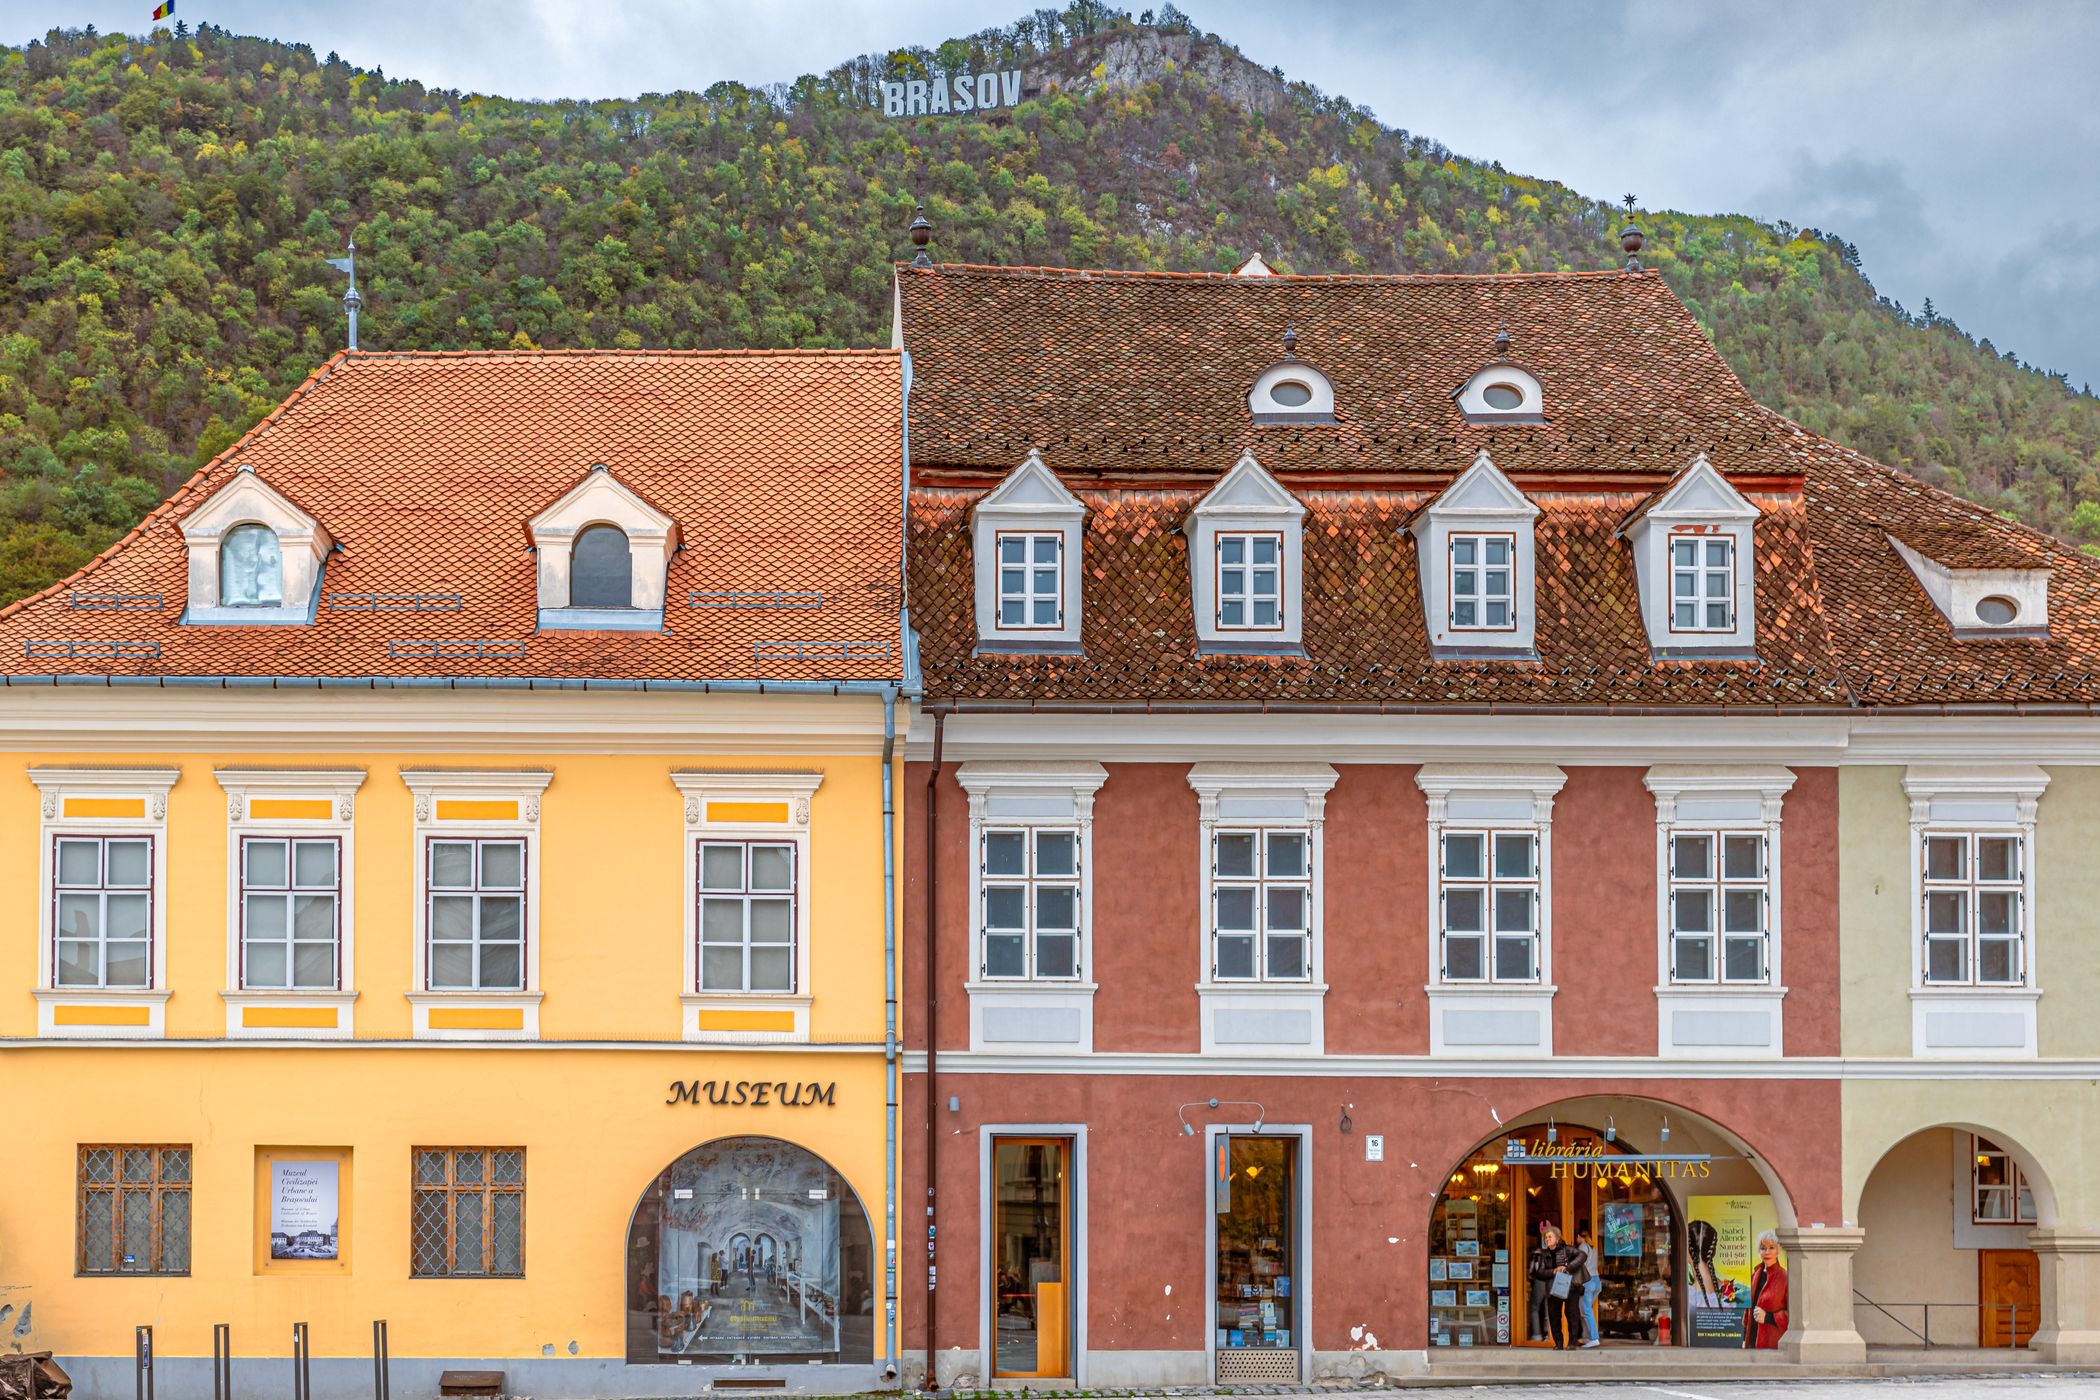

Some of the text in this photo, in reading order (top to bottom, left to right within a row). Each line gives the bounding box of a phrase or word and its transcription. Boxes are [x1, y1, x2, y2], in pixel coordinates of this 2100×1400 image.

[884, 70, 1021, 117] BRASOV
[665, 1080, 836, 1106] MUSEUM
[1371, 1139, 1379, 1147] 16
[1530, 1139, 1603, 1158] librăria
[1550, 1160, 1711, 1178] HUMANITAS
